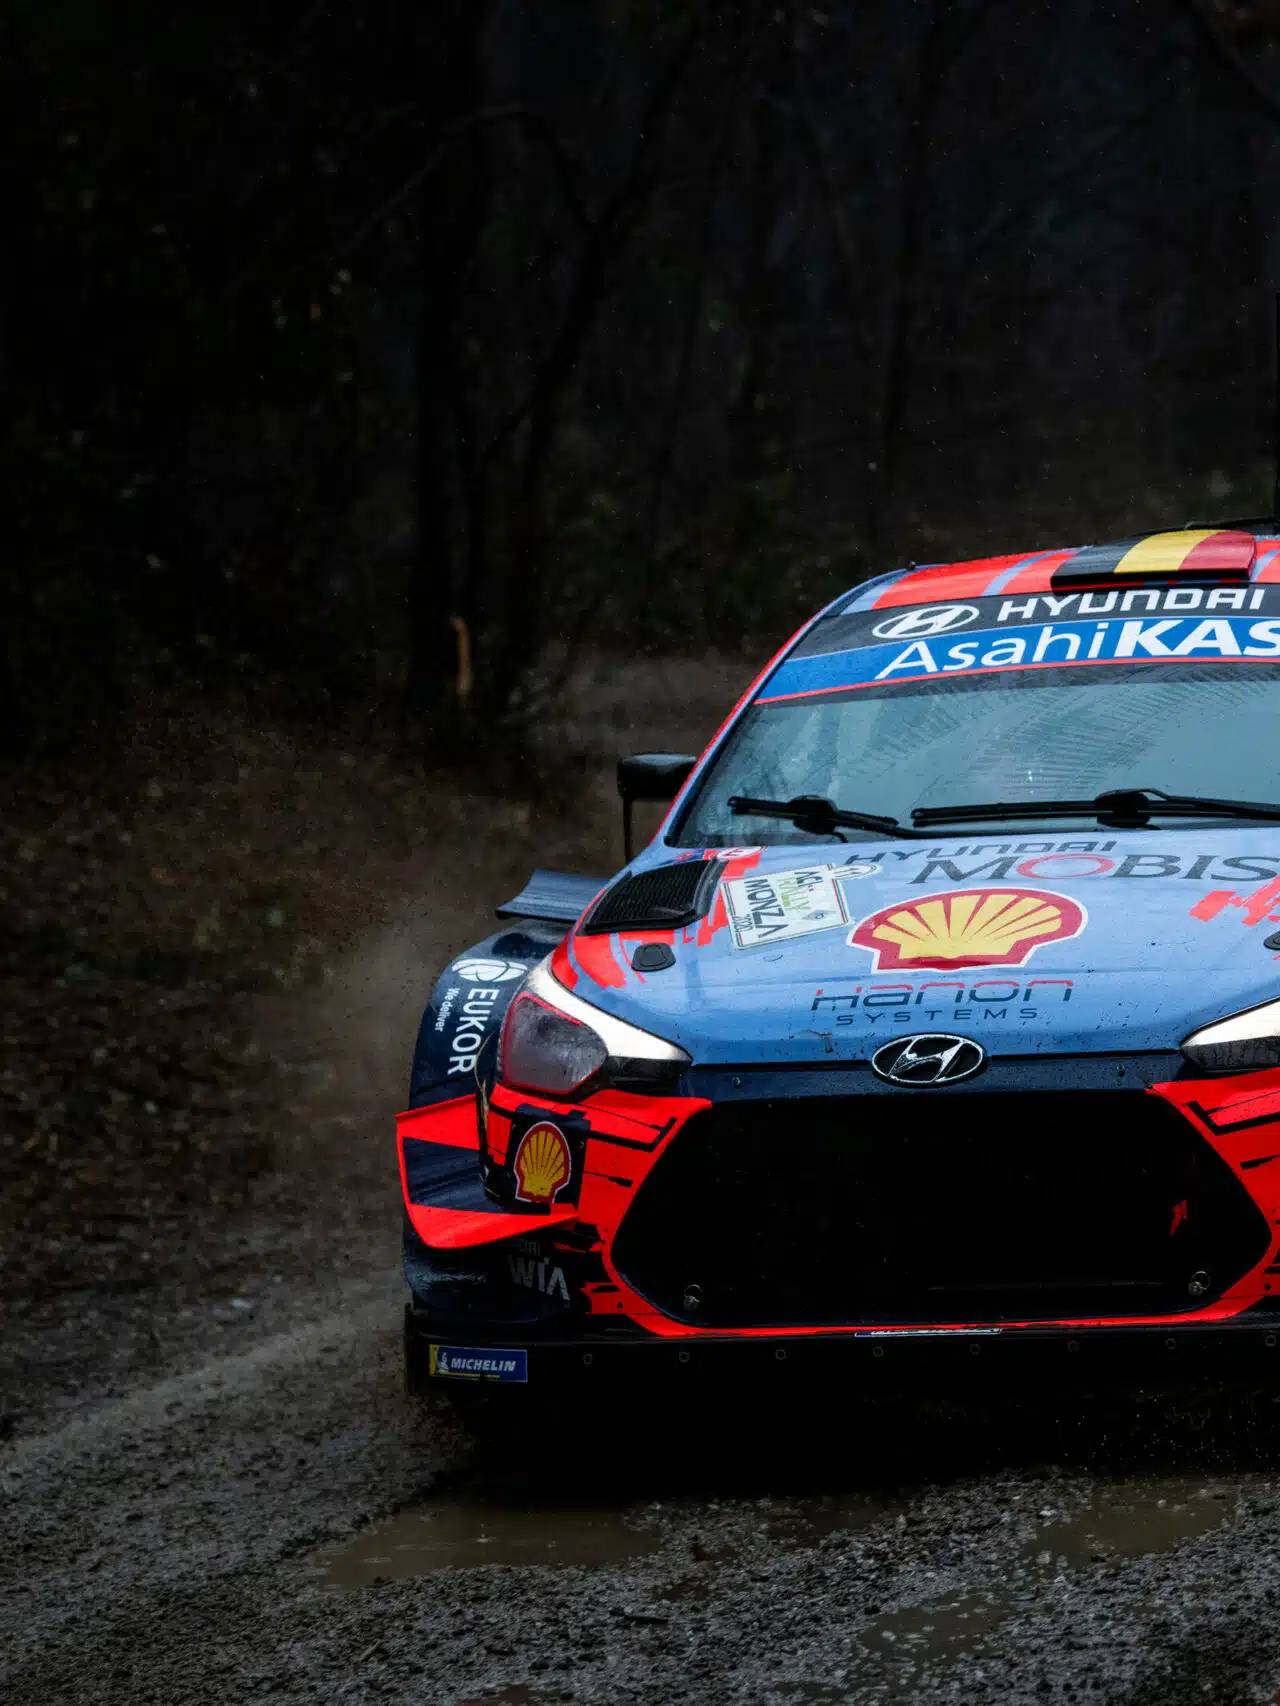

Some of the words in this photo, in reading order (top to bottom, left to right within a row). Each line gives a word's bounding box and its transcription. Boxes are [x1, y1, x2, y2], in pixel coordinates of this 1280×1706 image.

[996, 588, 1266, 622] HYUNDAI
[844, 841, 1117, 864] HYUNDAI
[744, 878, 789, 938] MONZA
[444, 987, 461, 1003] We
[434, 1001, 453, 1033] deliver
[447, 988, 499, 1076] EUKOR
[836, 1008, 1038, 1026] SYSTEMS
[508, 1255, 571, 1302] WIA
[451, 1358, 517, 1373] MICHELIN
